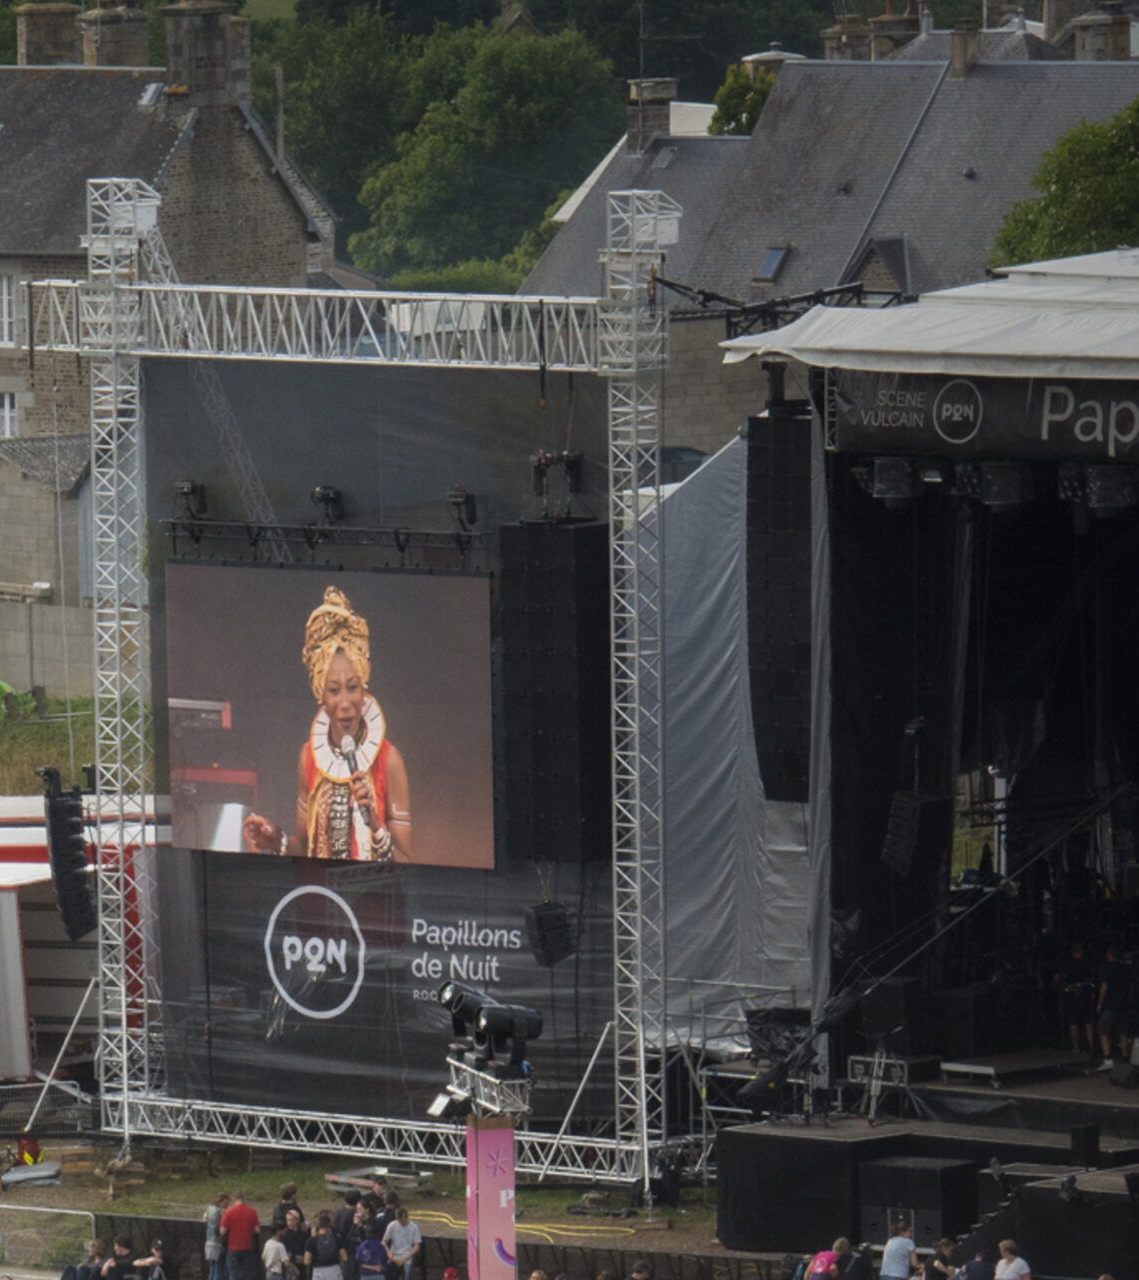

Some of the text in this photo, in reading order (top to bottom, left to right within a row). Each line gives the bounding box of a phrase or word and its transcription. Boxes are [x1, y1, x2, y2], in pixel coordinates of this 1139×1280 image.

[861, 409, 925, 429] VULCAIN
[412, 918, 521, 950] Papillons
[412, 953, 500, 982] de Nuit
